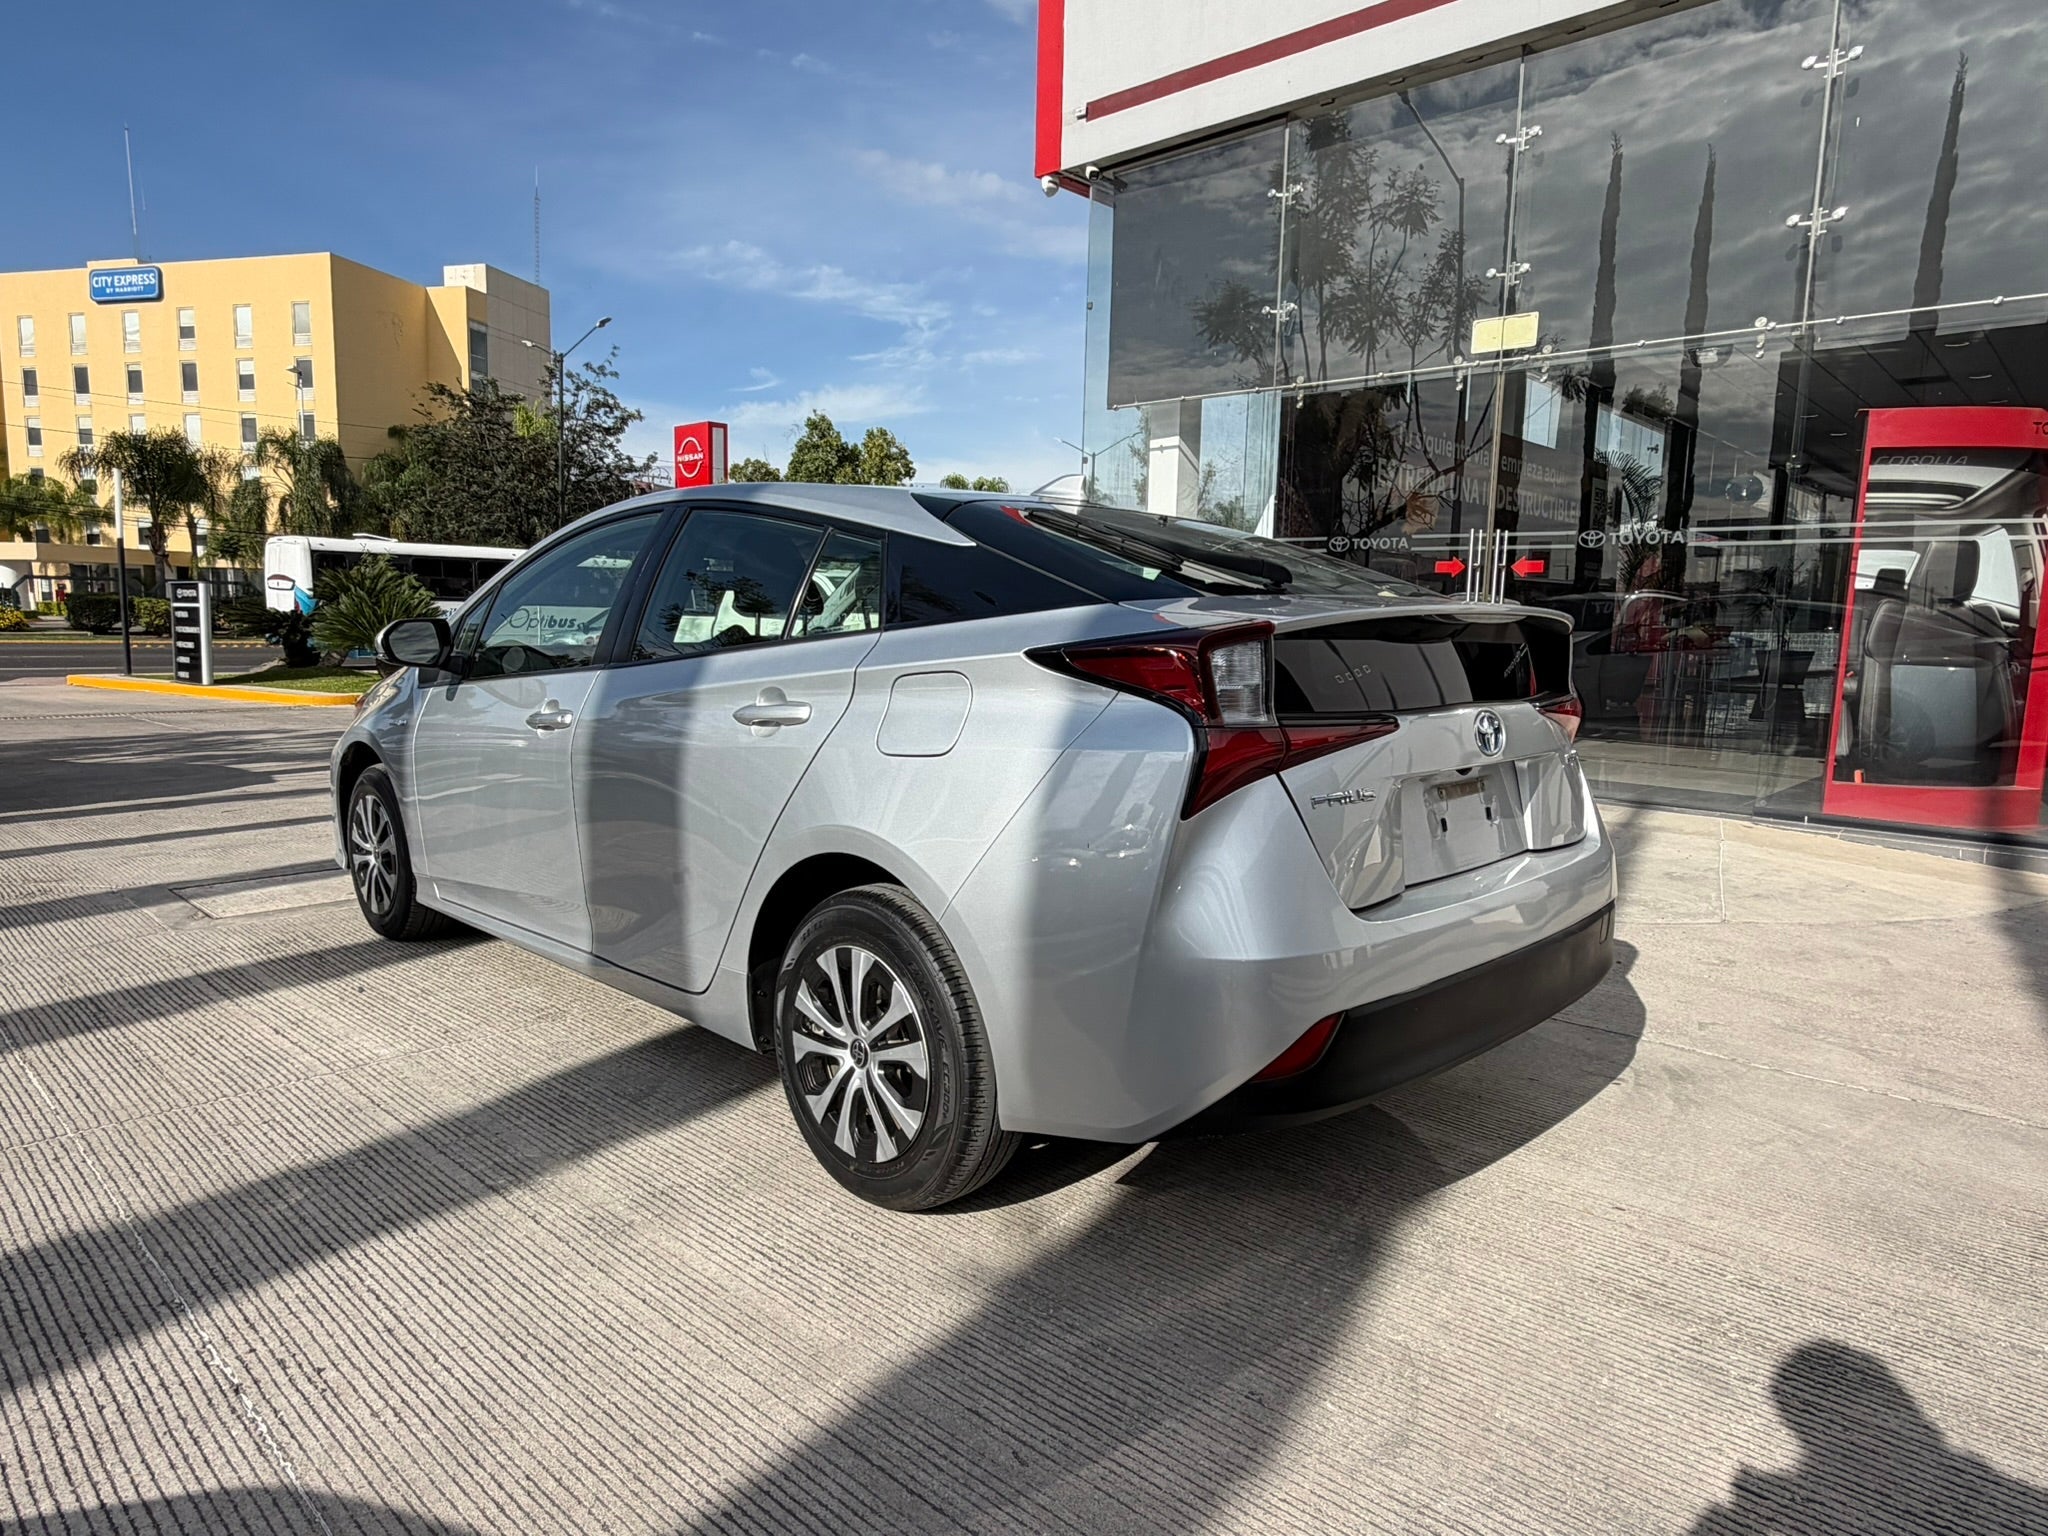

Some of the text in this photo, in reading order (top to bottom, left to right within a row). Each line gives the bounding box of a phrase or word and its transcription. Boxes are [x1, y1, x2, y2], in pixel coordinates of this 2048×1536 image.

[93, 273, 155, 287] CITY EXPRESS
[677, 452, 704, 462] NISSAN
[1874, 455, 1968, 466] COROLLA
[1450, 472, 1481, 505] UNA
[1351, 536, 1409, 551] TOYOTA
[1608, 530, 1685, 546] TOYOTA
[509, 607, 577, 632] Optibus
[1310, 788, 1377, 810] PRIUS
